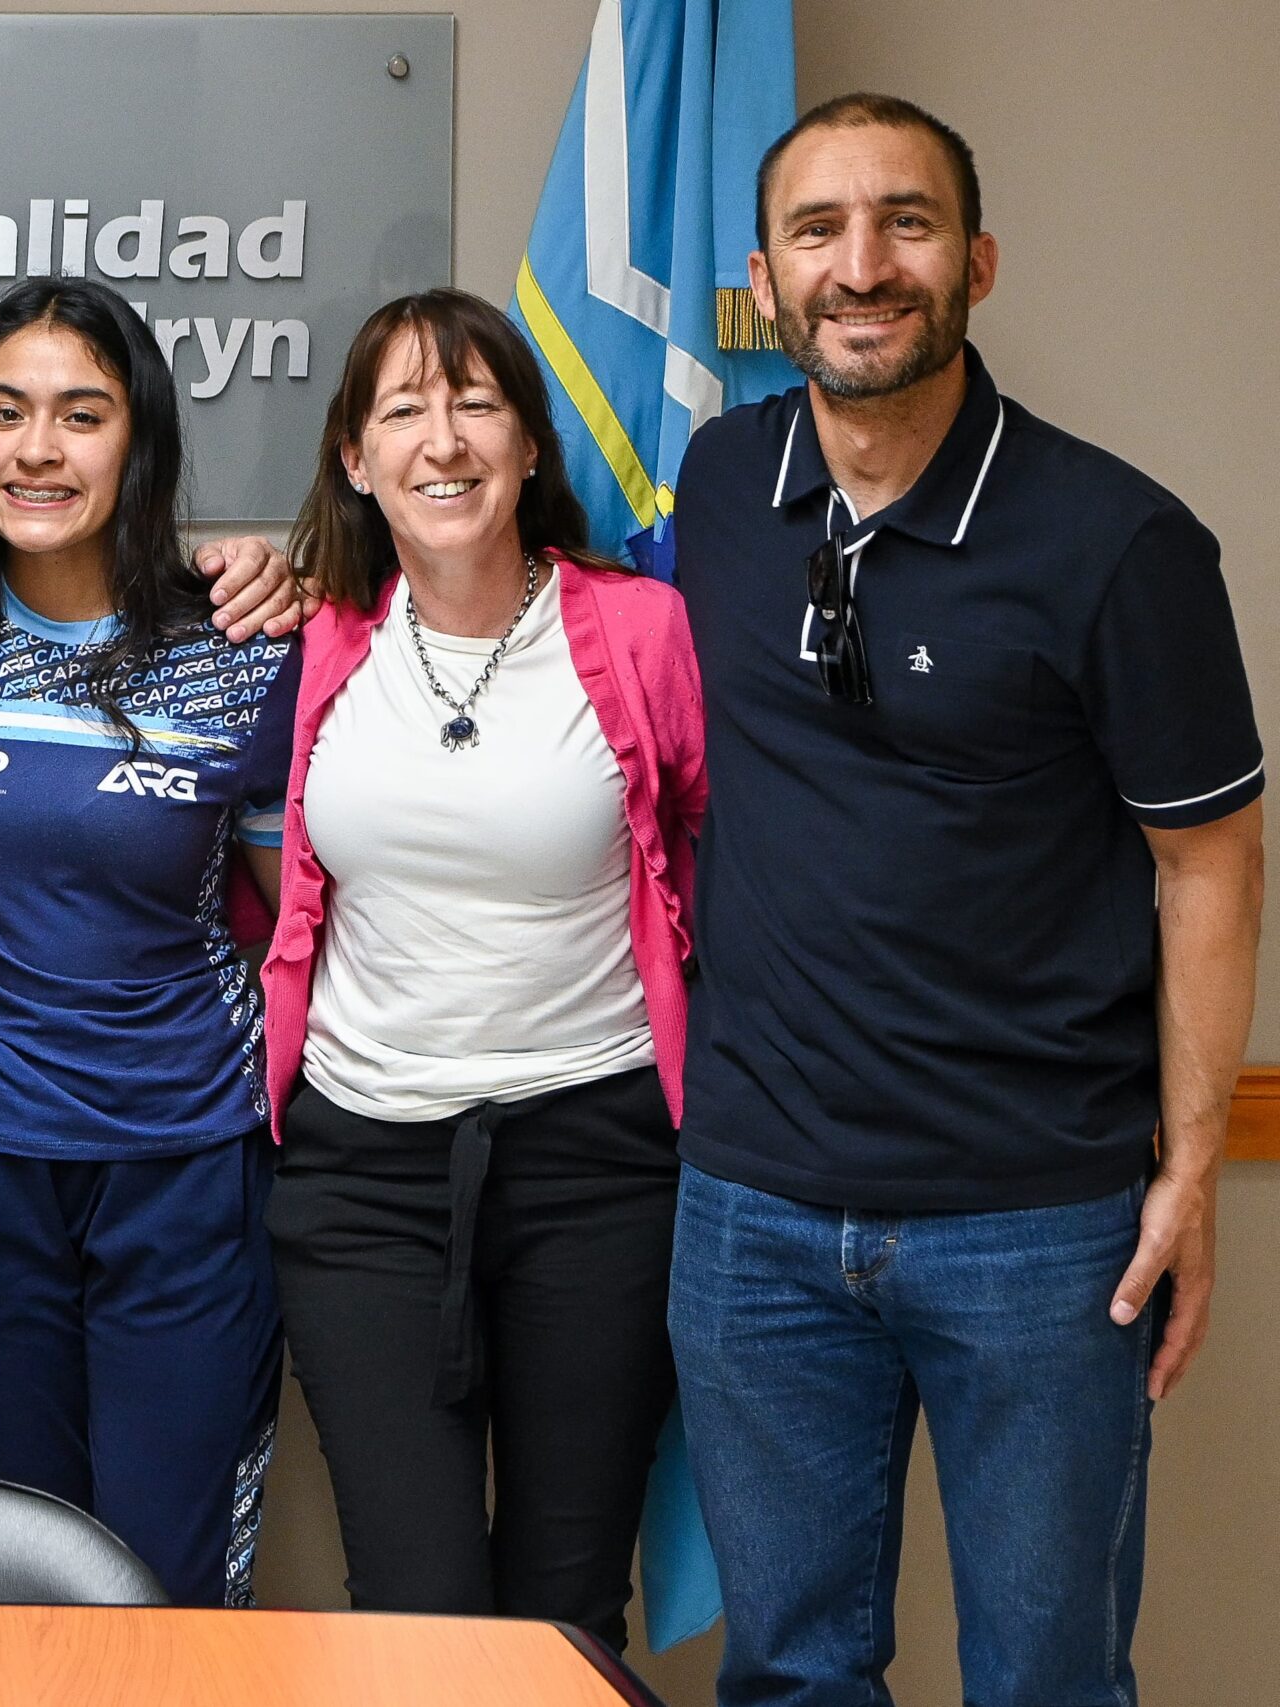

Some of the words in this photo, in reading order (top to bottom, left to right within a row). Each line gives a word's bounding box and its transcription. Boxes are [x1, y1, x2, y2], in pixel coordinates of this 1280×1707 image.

[127, 666, 174, 688] CAP
[173, 658, 215, 679] ARG
[216, 645, 264, 669] CAP
[131, 685, 177, 707] CAP
[177, 677, 219, 698] ARG
[218, 666, 267, 688] CAP
[182, 694, 224, 715] ARG
[223, 686, 268, 707] CAP
[96, 760, 198, 802] ARG
